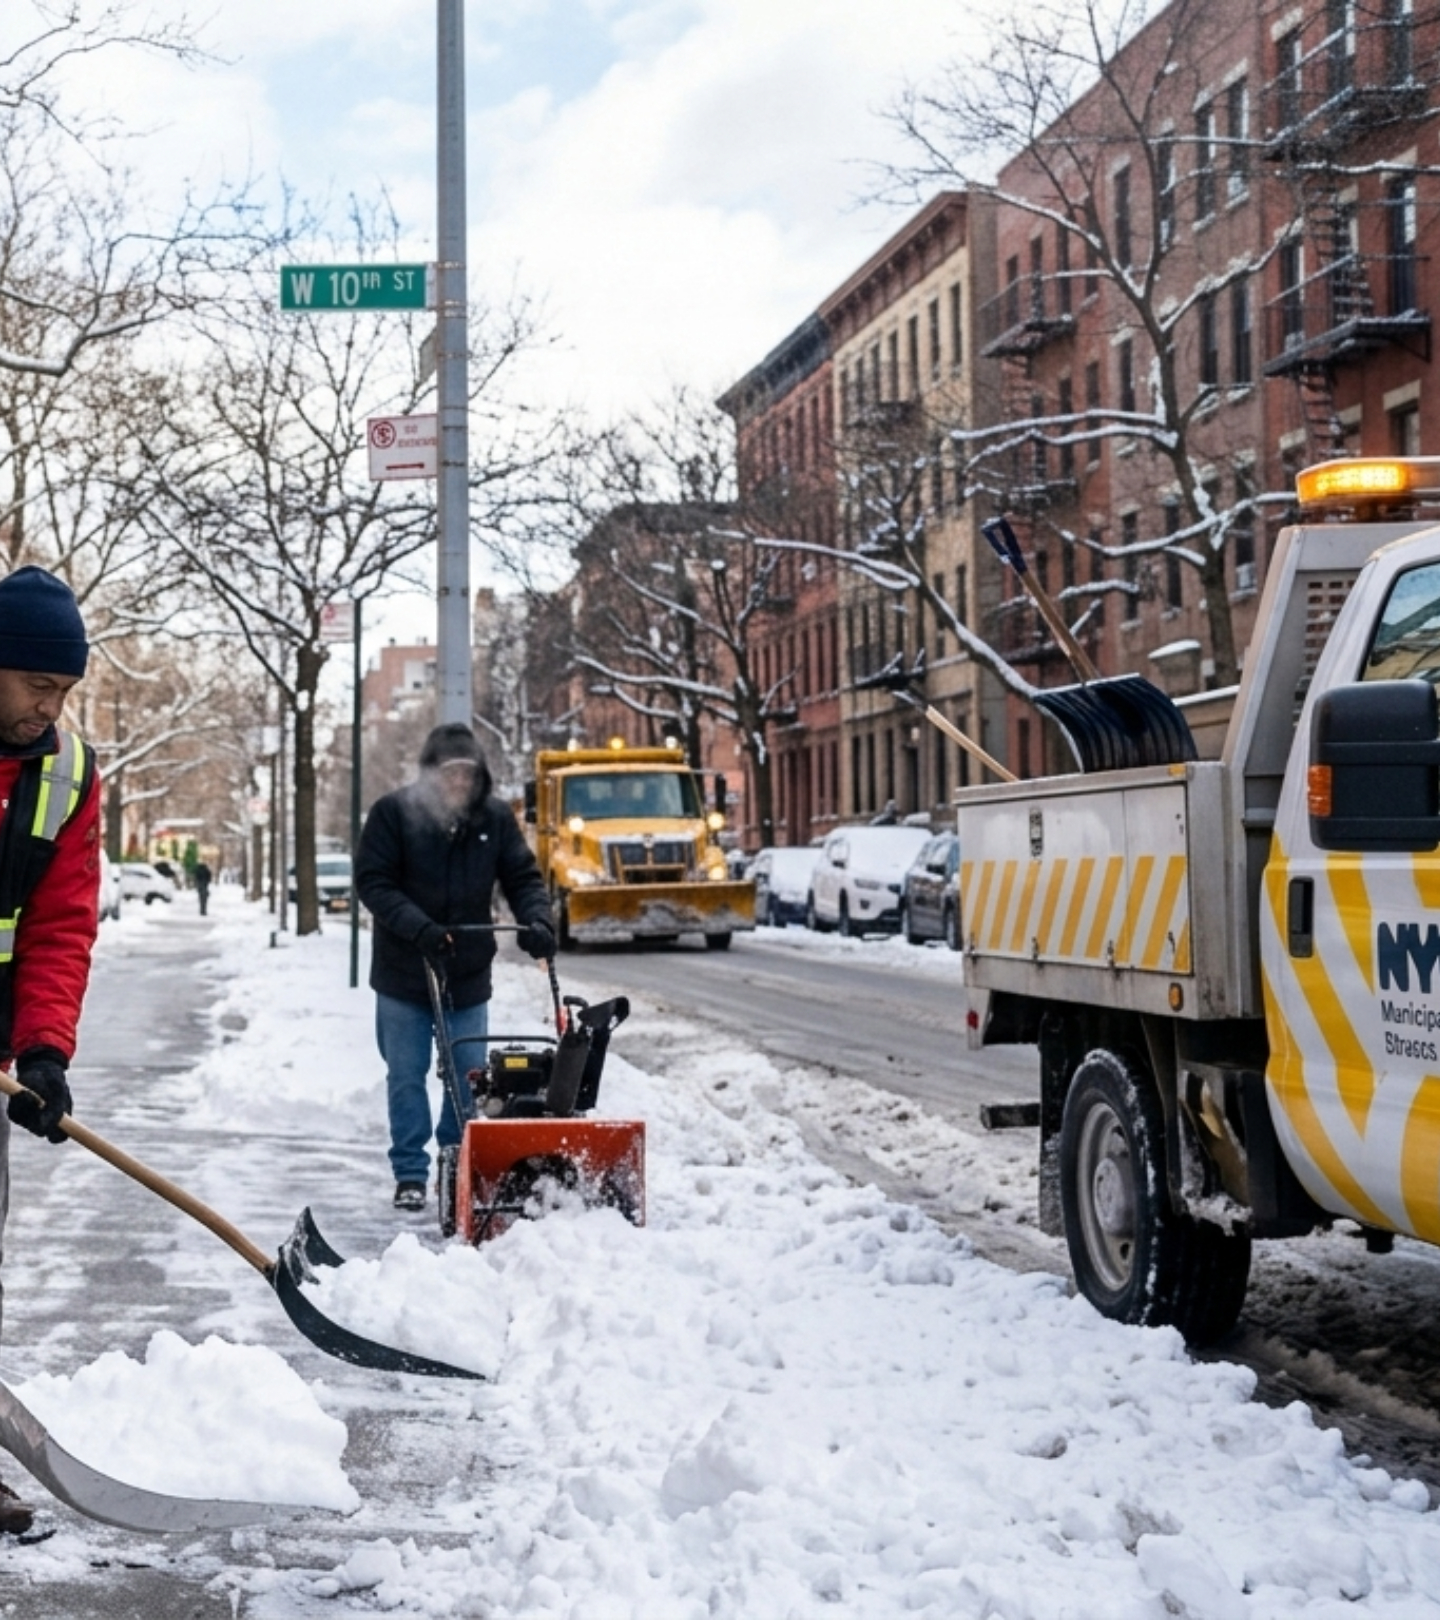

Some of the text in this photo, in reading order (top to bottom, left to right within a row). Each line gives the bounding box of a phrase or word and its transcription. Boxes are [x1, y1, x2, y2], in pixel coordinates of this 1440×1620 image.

[291, 272, 315, 305] W
[393, 270, 415, 291] ST
[1377, 921, 1440, 994] NY
